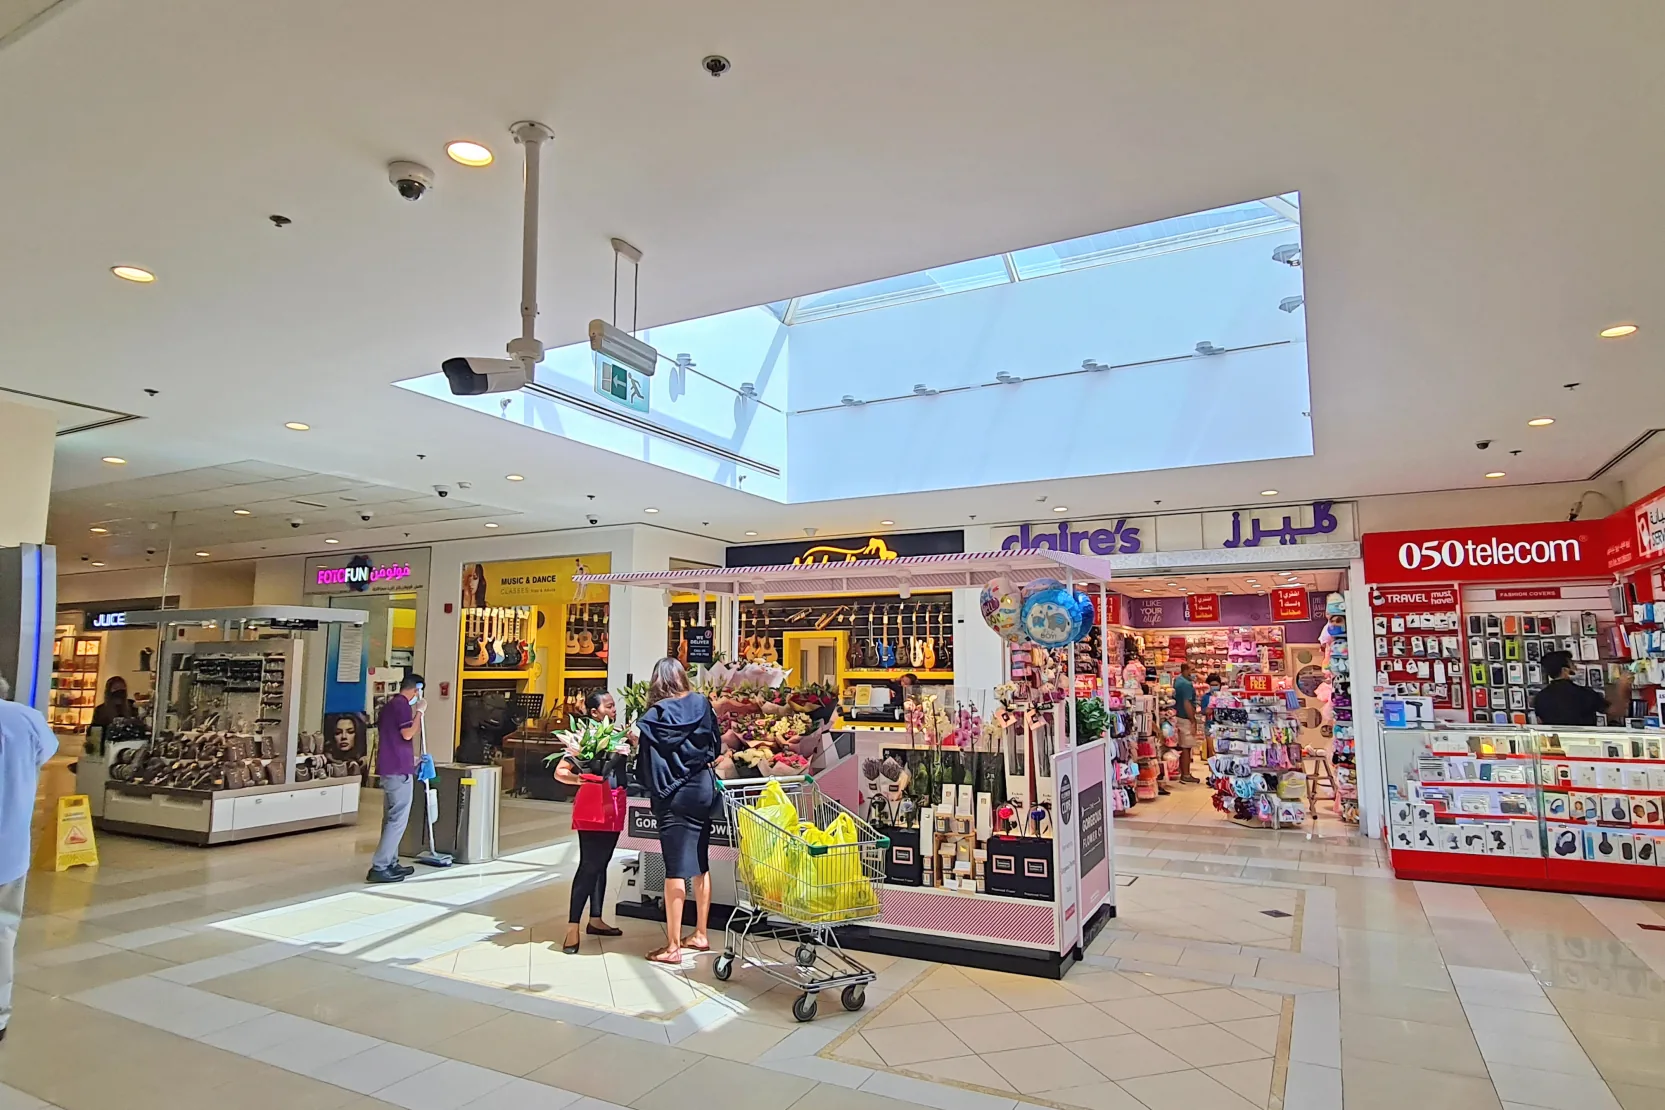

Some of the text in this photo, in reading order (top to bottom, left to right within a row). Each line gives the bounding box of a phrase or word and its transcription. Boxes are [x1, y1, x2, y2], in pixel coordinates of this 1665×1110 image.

[1001, 518, 1141, 555] claire's
[317, 566, 369, 585] FOTOFUN
[501, 574, 556, 585] MUSIC & DANCE
[1386, 590, 1451, 603] TRAVEL must
[1097, 612, 1113, 622] FEE
[1140, 607, 1162, 615] YOUR
[93, 612, 126, 627] JUICE
[1250, 680, 1267, 690] FREE
[635, 817, 658, 829] GOR
[1082, 808, 1102, 832] GORGEOUS
[1082, 829, 1098, 849] FLOWER
